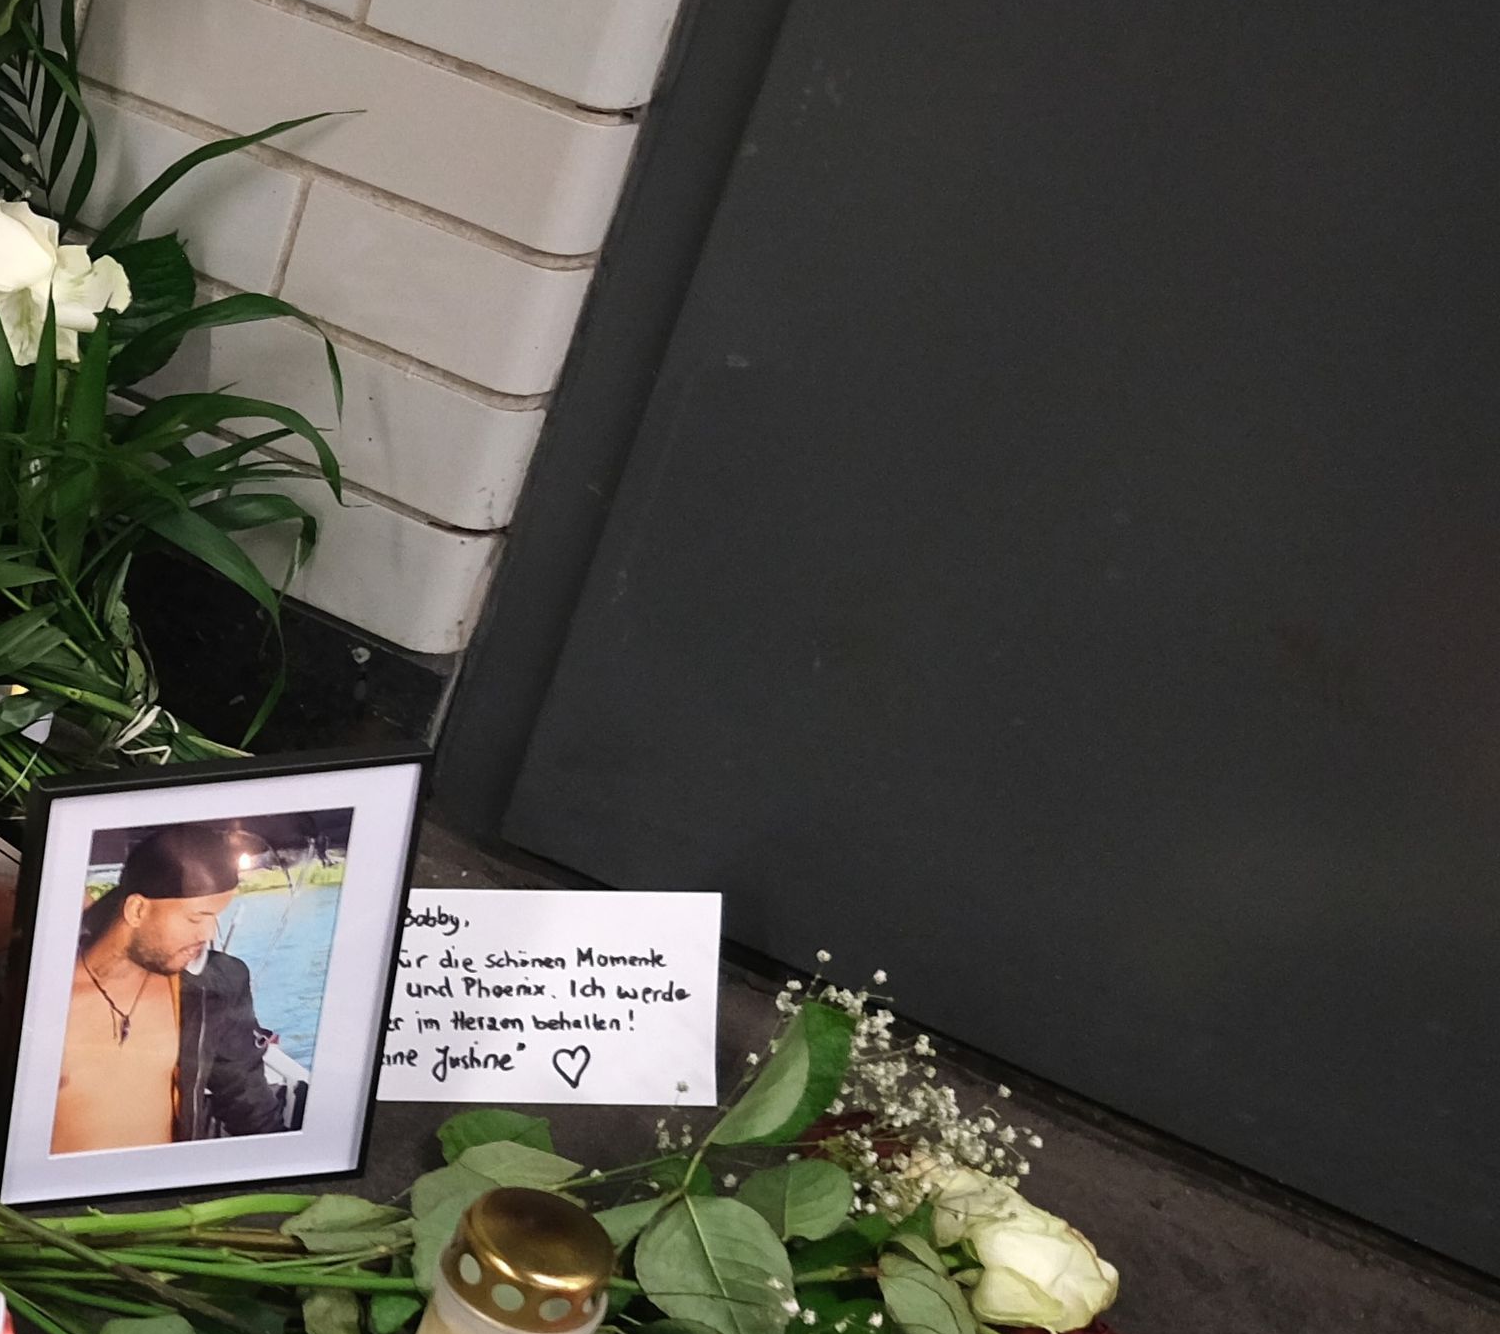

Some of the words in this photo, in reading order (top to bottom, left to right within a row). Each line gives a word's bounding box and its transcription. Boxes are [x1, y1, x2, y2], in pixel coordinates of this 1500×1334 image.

[399, 948, 428, 969] ür
[438, 945, 477, 972] die
[484, 950, 566, 970] schönen
[576, 946, 668, 968] Momente
[406, 977, 454, 998] und
[569, 977, 605, 998] Ich
[616, 980, 691, 1004] werde
[386, 1016, 404, 1032] er
[414, 1011, 440, 1034] im
[450, 1010, 525, 1032] Herzen
